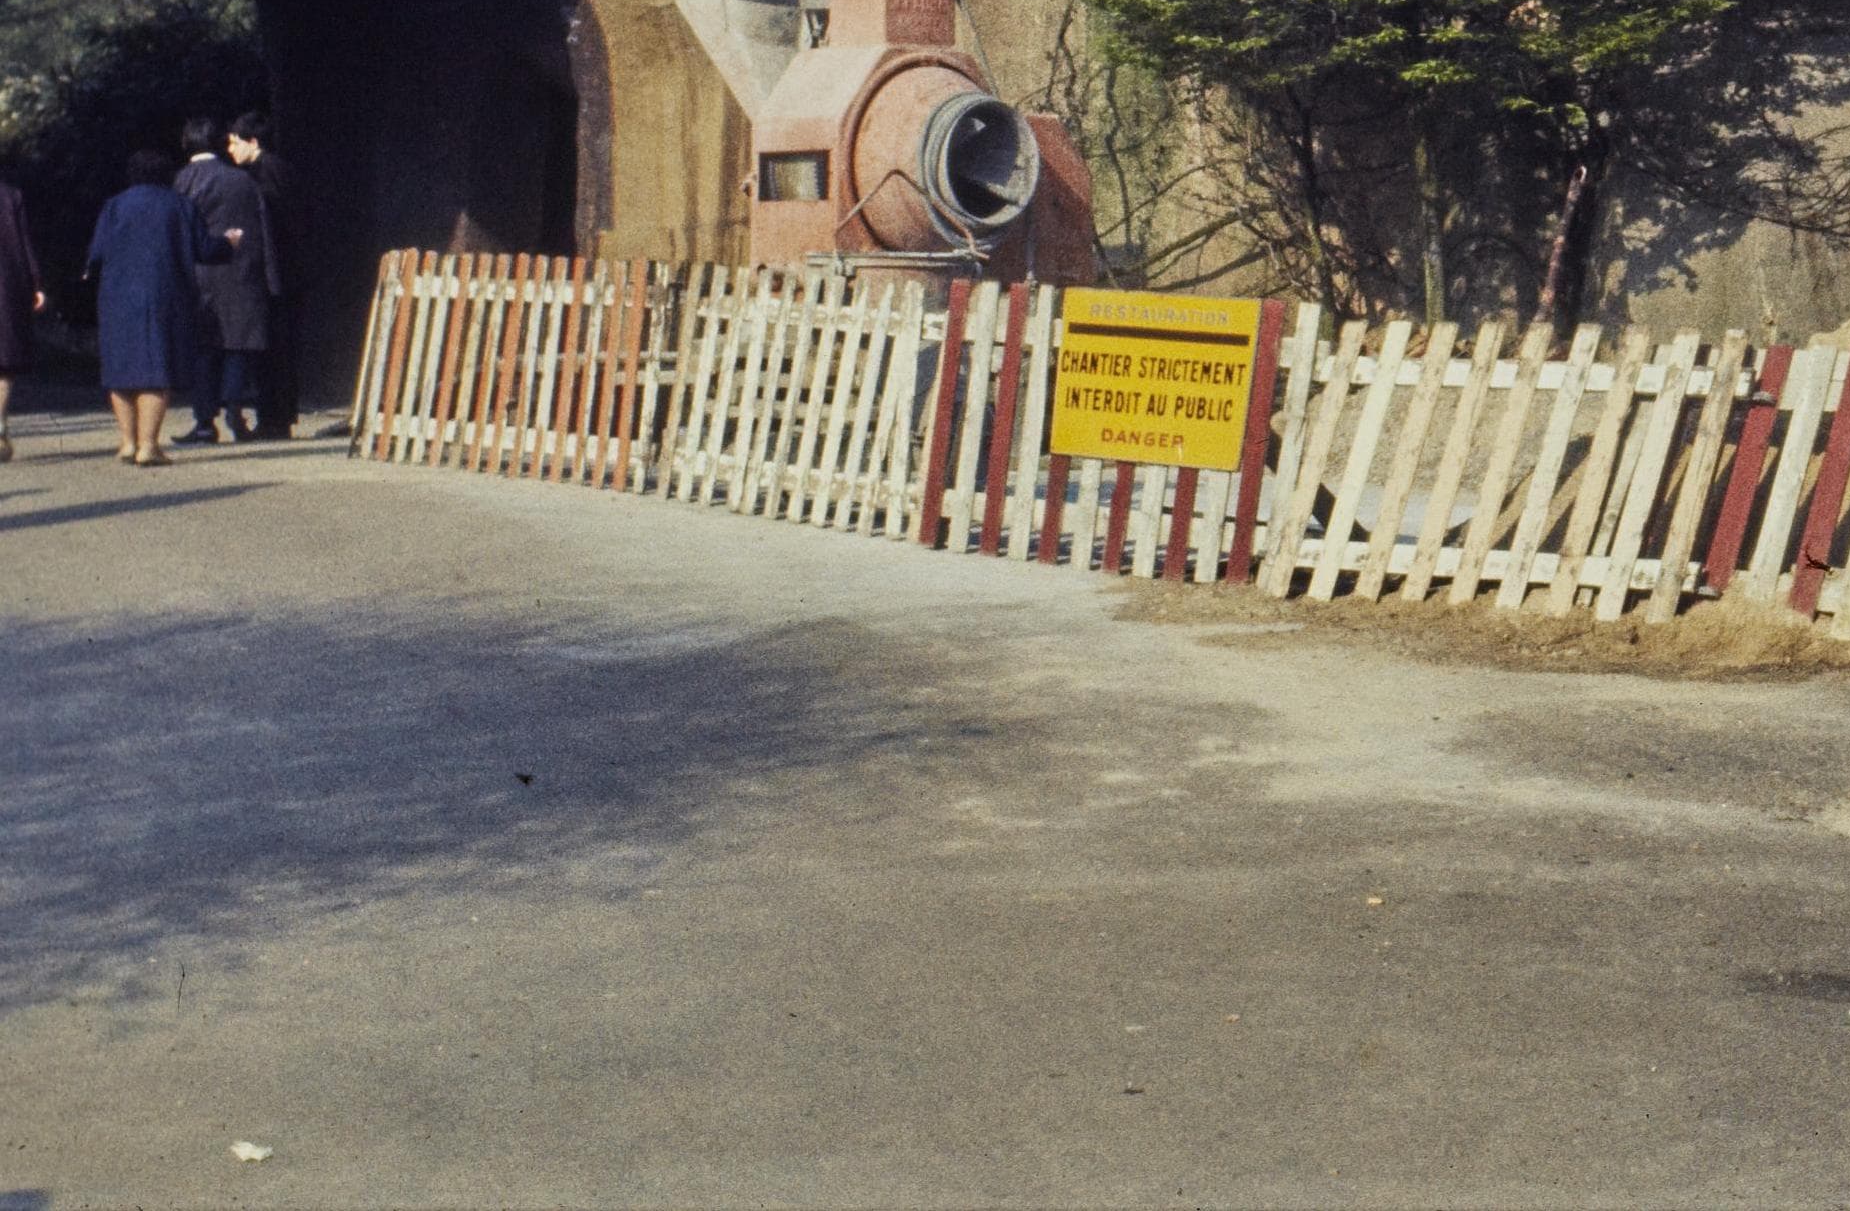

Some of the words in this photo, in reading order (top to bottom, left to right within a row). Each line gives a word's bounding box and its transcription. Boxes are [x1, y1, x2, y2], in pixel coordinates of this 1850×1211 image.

[1061, 350, 1132, 378] CHANTIER
[1138, 357, 1246, 386] STRICTEMENT
[1065, 387, 1142, 415] INTERDIT
[1146, 395, 1167, 416] AU
[1174, 396, 1233, 422] PUBLIC
[1101, 428, 1184, 448] DANGER
